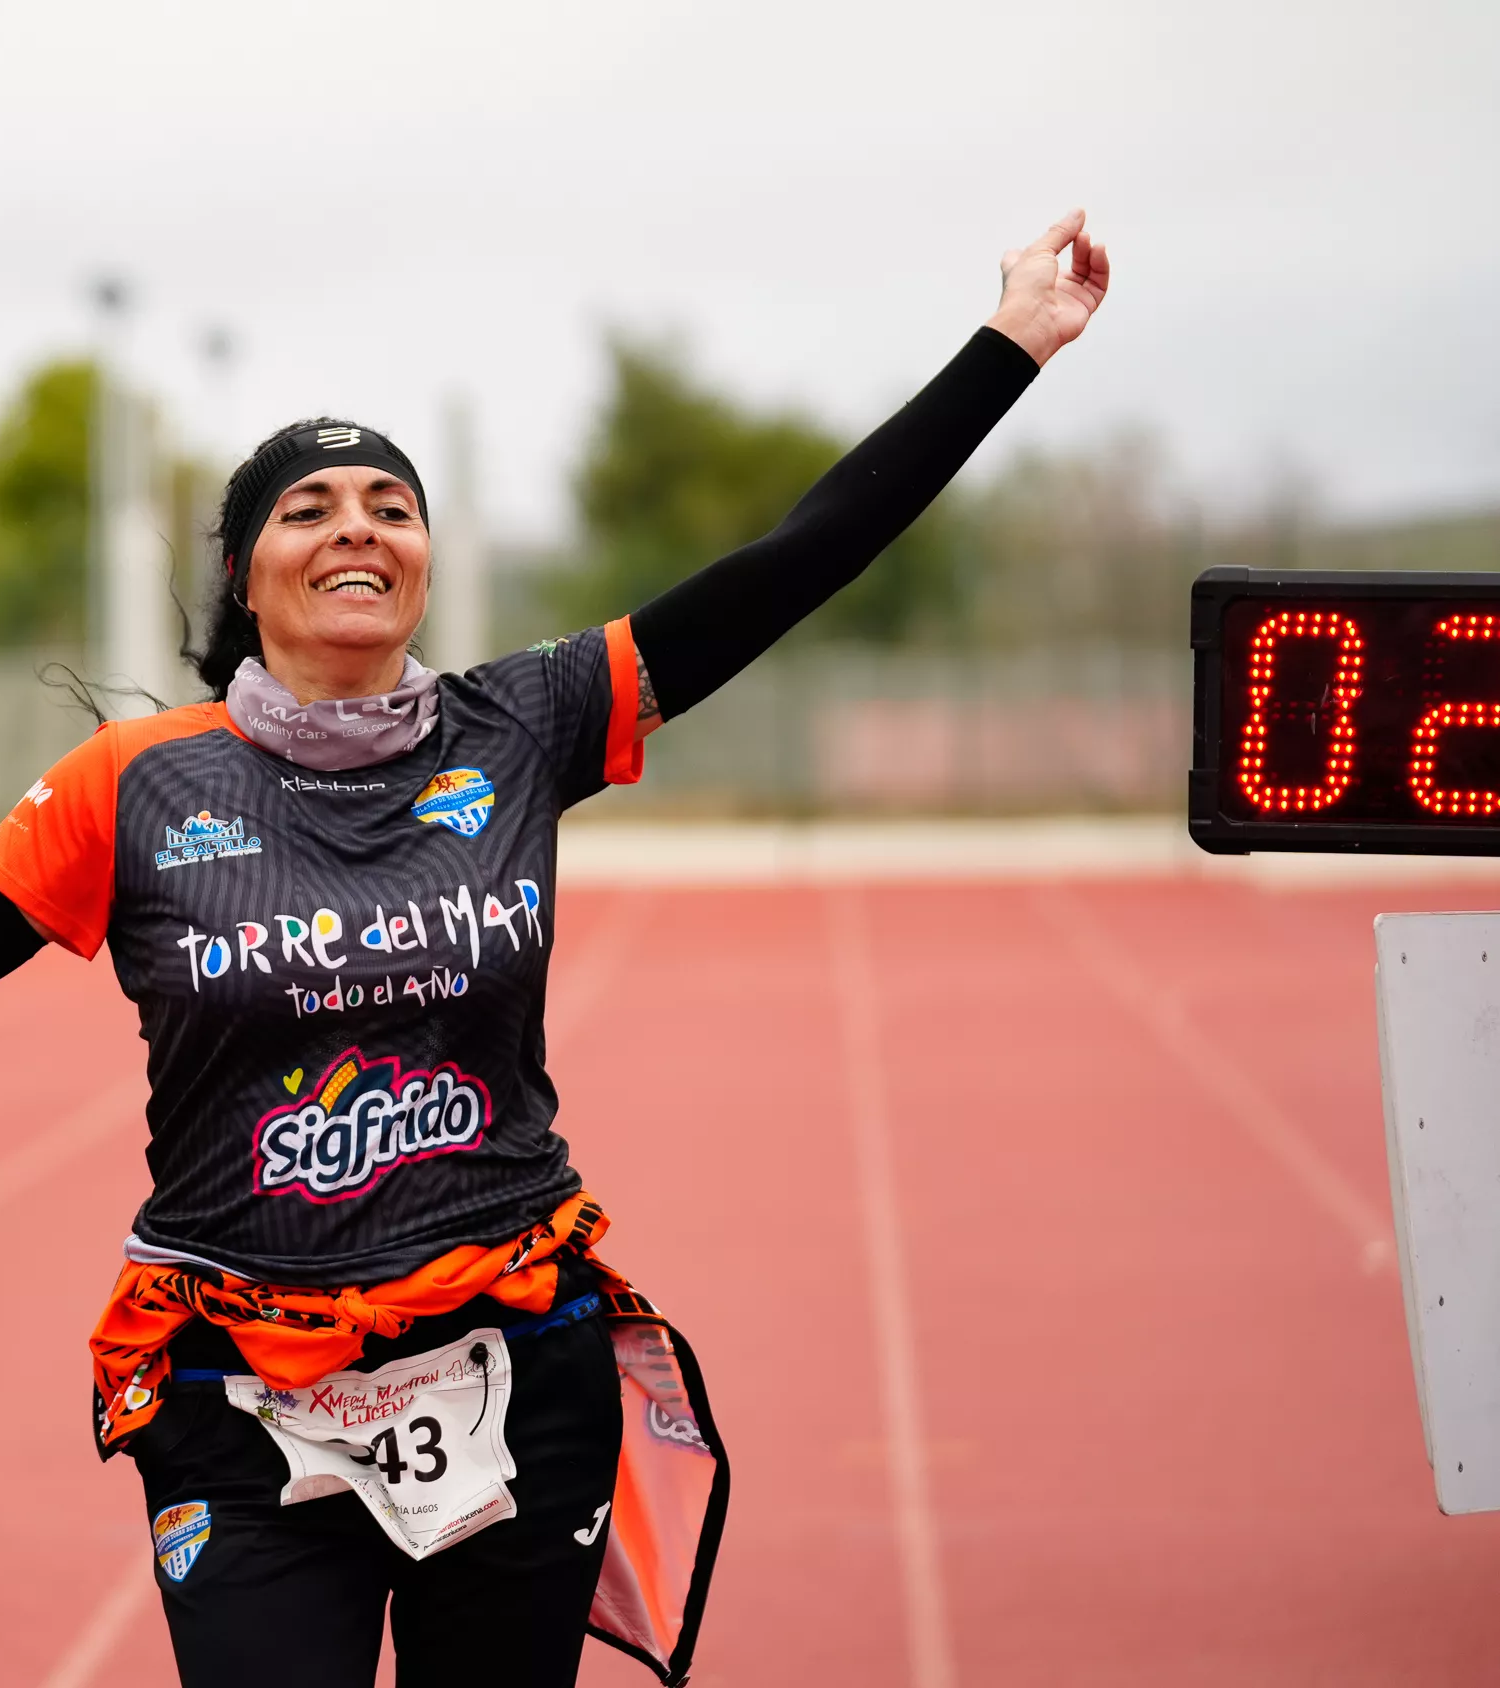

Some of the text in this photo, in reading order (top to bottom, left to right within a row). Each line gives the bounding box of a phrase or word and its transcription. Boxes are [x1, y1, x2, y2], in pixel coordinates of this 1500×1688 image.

[247, 715, 328, 740] Mobility Cars
[1239, 612, 1500, 814] 02
[155, 836, 262, 864] EL SALTILLO
[360, 900, 428, 954] del
[438, 878, 543, 970] MAR
[372, 974, 394, 1005] el
[264, 1076, 476, 1188] Sigfrido
[411, 1503, 439, 1515] LAGOS
